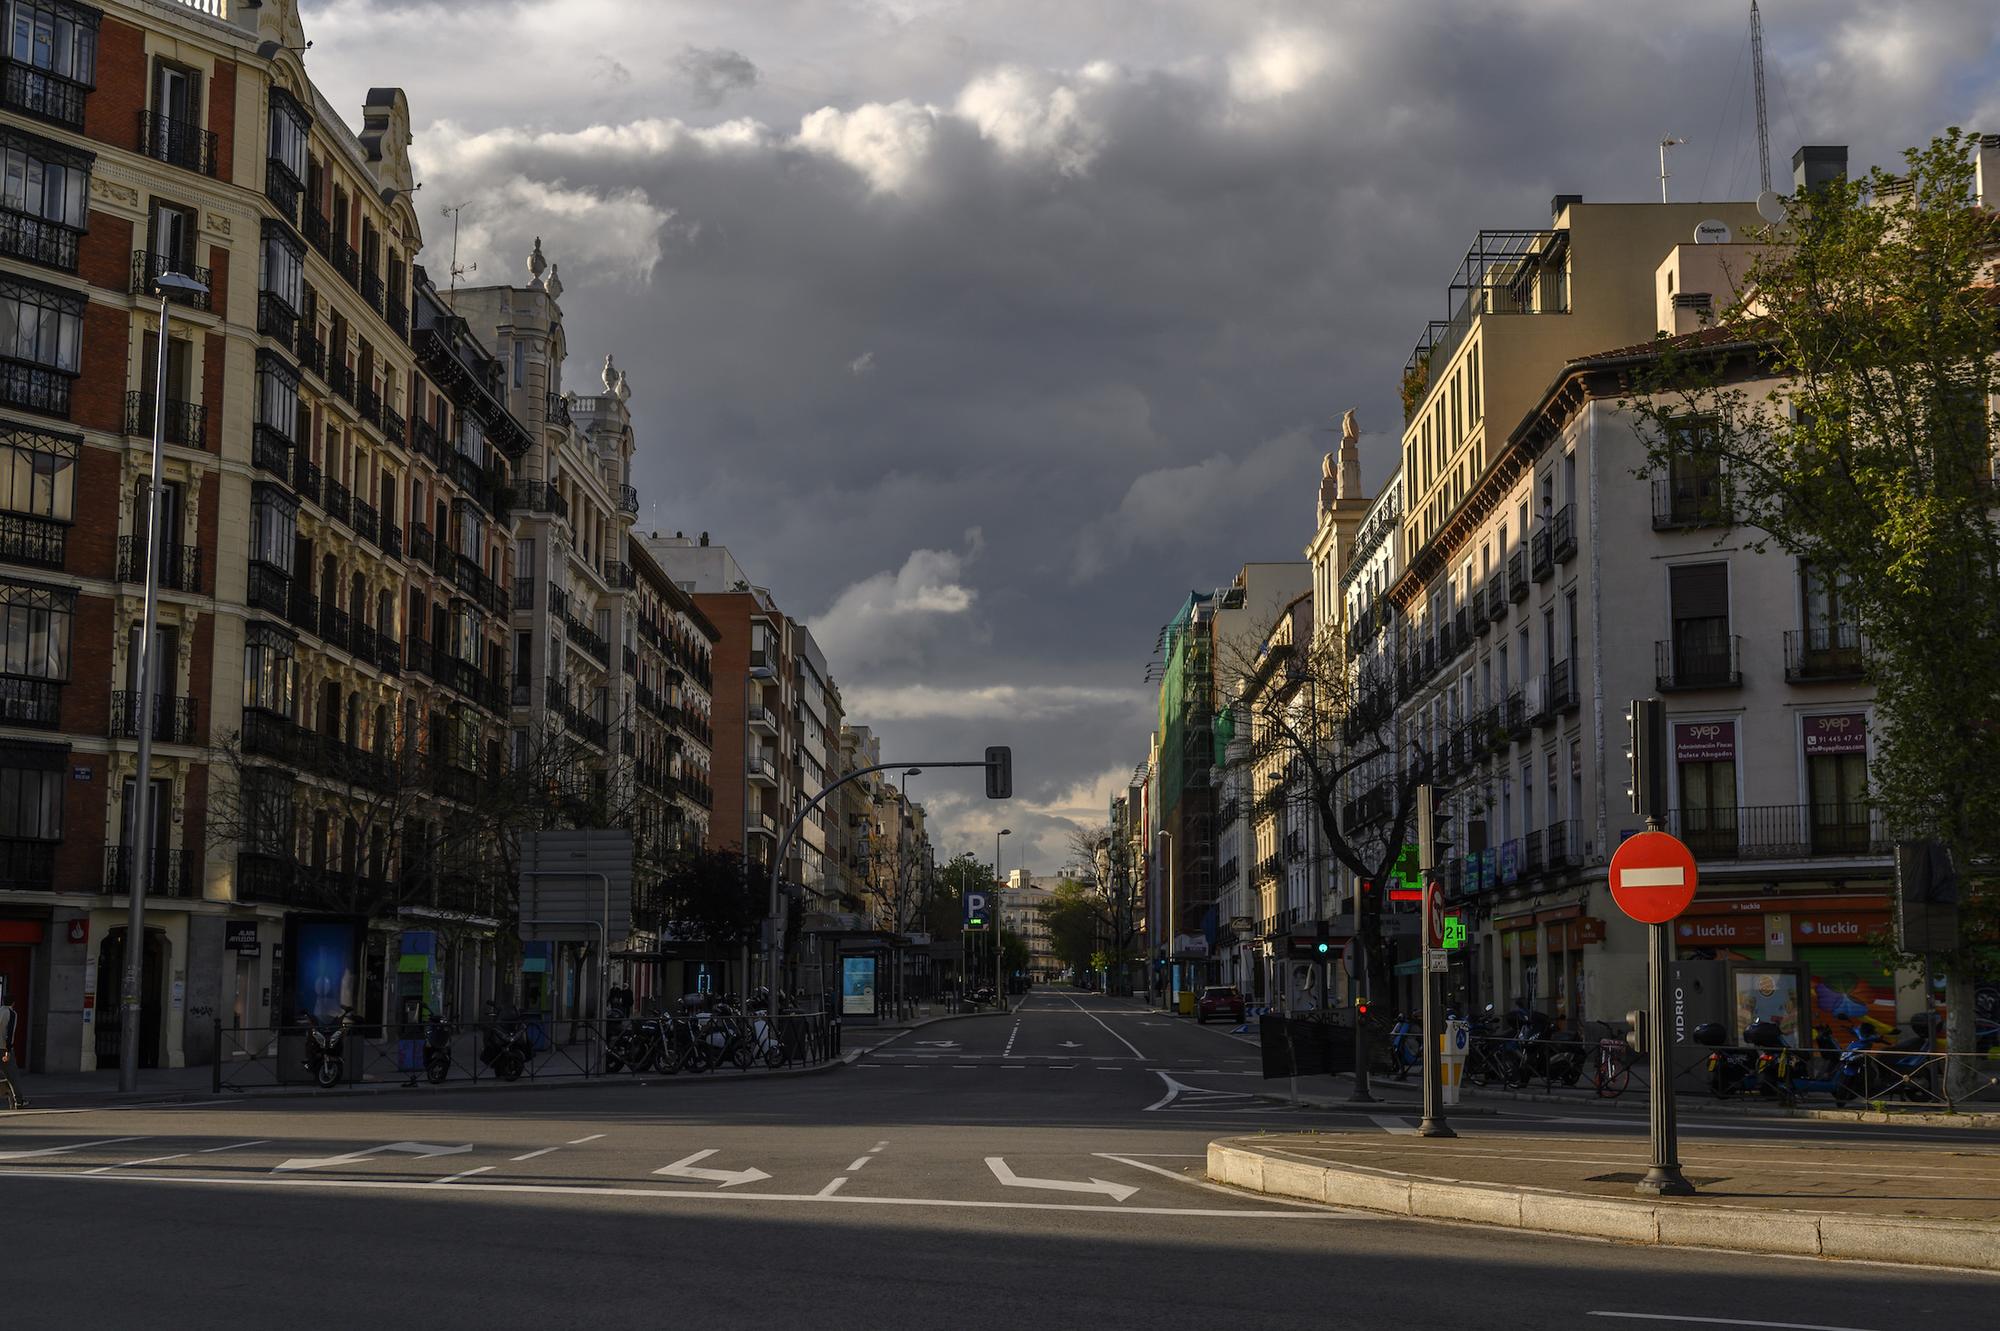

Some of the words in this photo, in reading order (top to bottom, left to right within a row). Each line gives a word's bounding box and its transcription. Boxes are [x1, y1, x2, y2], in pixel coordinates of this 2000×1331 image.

[1818, 717, 1850, 732] syep
[1690, 725, 1721, 740] syep
[968, 894, 985, 919] P
[1696, 924, 1736, 937] luckia
[1817, 921, 1859, 934] luckia
[1674, 987, 1685, 1043] VIDRIO
